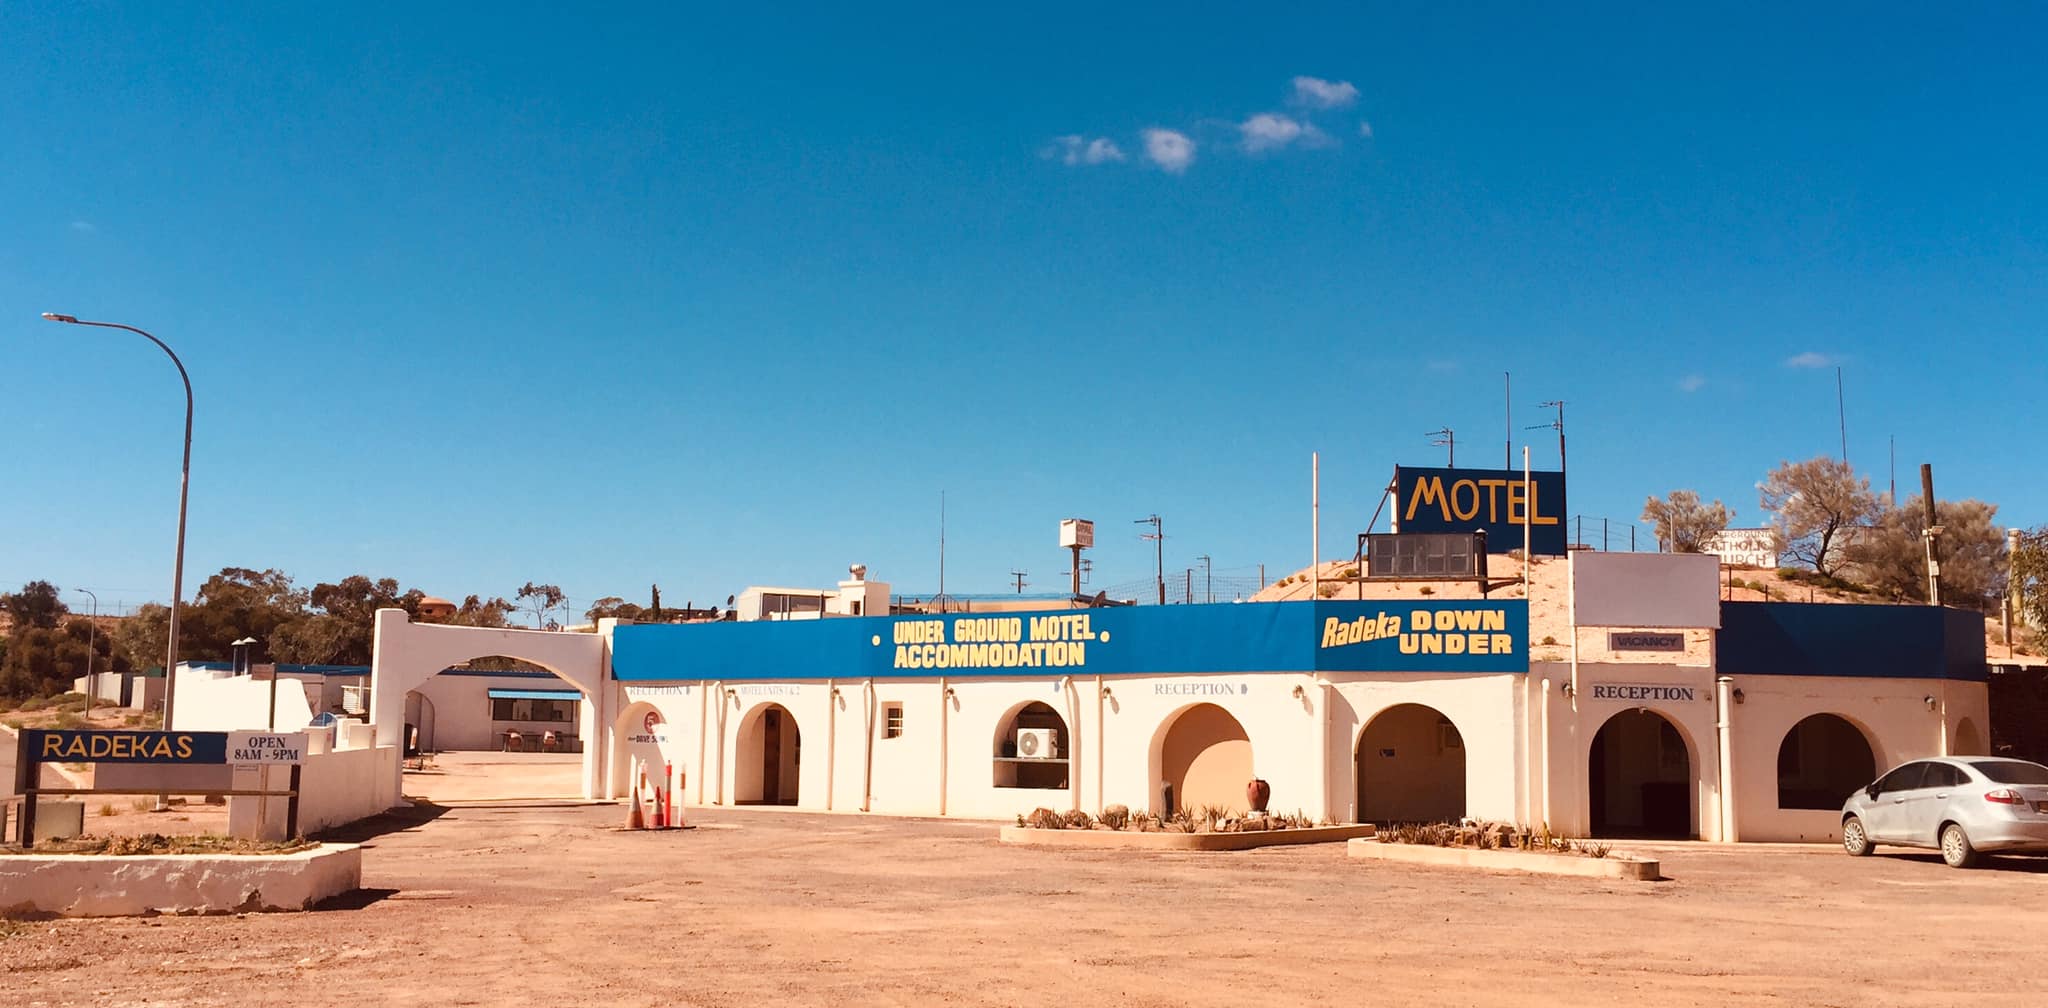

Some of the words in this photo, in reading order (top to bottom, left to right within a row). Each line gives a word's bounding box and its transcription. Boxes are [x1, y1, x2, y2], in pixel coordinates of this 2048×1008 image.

[1405, 475, 1559, 525] MOTEL
[893, 620, 945, 645] UNDER
[954, 617, 1022, 643] GROUND
[1029, 614, 1096, 641] MOTEL
[1321, 611, 1402, 648] Radeka
[1410, 609, 1505, 631] DOWN
[1398, 633, 1513, 655] UNDER
[1616, 636, 1679, 648] VACANCY
[893, 641, 1085, 669] ACCOMMODATION
[1154, 683, 1235, 695] RECEPTION
[1593, 685, 1695, 701] RECEPTION
[42, 734, 193, 760] RADEKAS
[248, 737, 286, 748] OPEN
[234, 749, 262, 761] 8AM
[272, 749, 299, 761] 9PM
